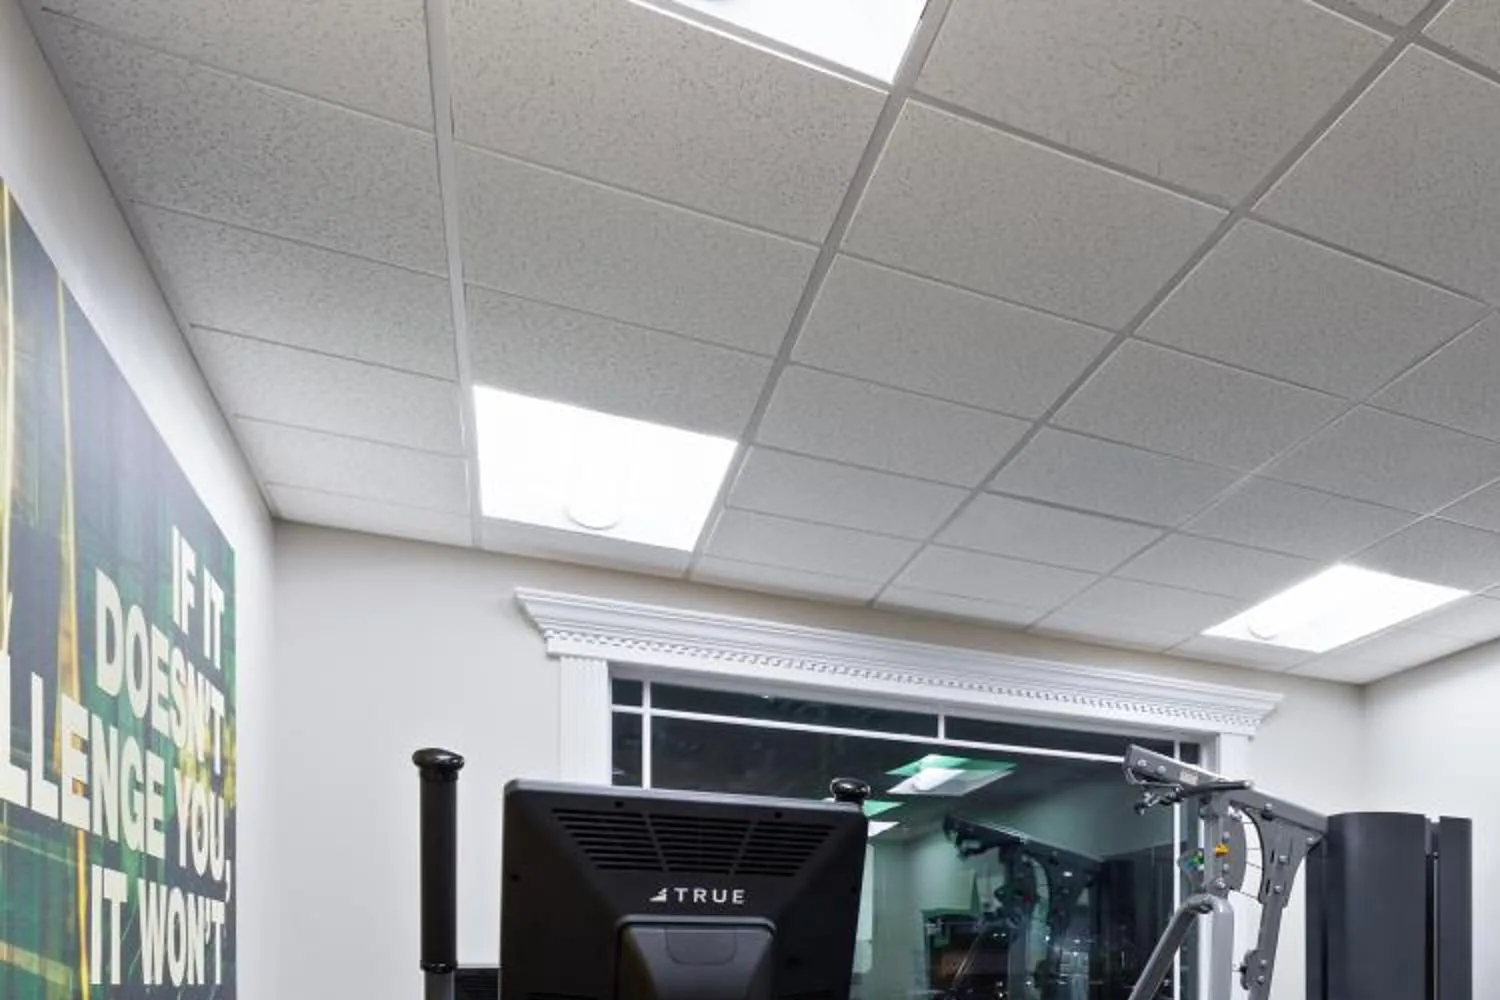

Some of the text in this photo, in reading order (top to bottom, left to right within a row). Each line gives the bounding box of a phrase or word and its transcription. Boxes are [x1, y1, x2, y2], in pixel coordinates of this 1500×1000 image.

[172, 526, 225, 669] IF IT
[96, 568, 225, 774] DOESN'T
[0, 654, 230, 901] LLENGE YOU,
[91, 864, 225, 986] IT WON'T
[673, 887, 745, 904] TRUE
